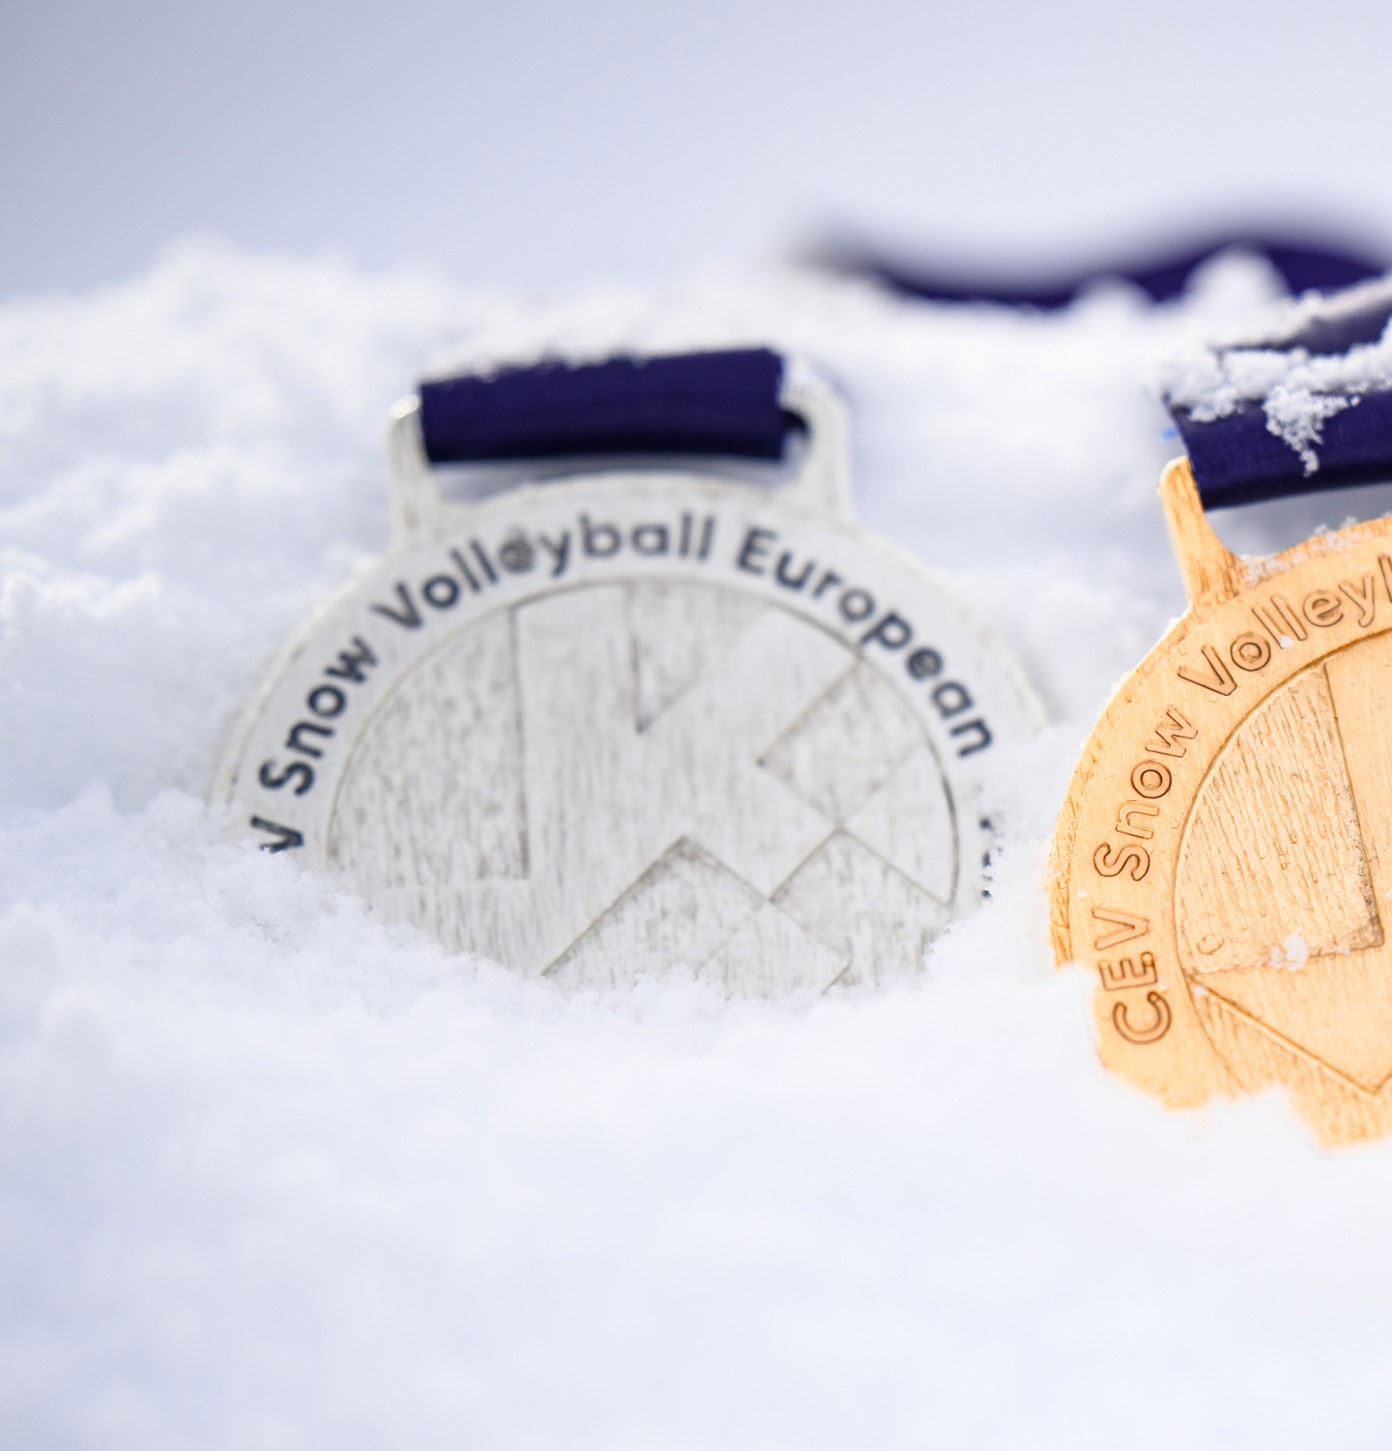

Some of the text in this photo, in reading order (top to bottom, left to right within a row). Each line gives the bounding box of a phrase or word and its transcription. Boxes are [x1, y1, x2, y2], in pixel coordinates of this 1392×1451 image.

[259, 636, 379, 796] Snow
[372, 514, 717, 631] Volleyball
[736, 527, 993, 757] European
[1094, 706, 1199, 882] Snow
[1094, 910, 1172, 1046] CEV
